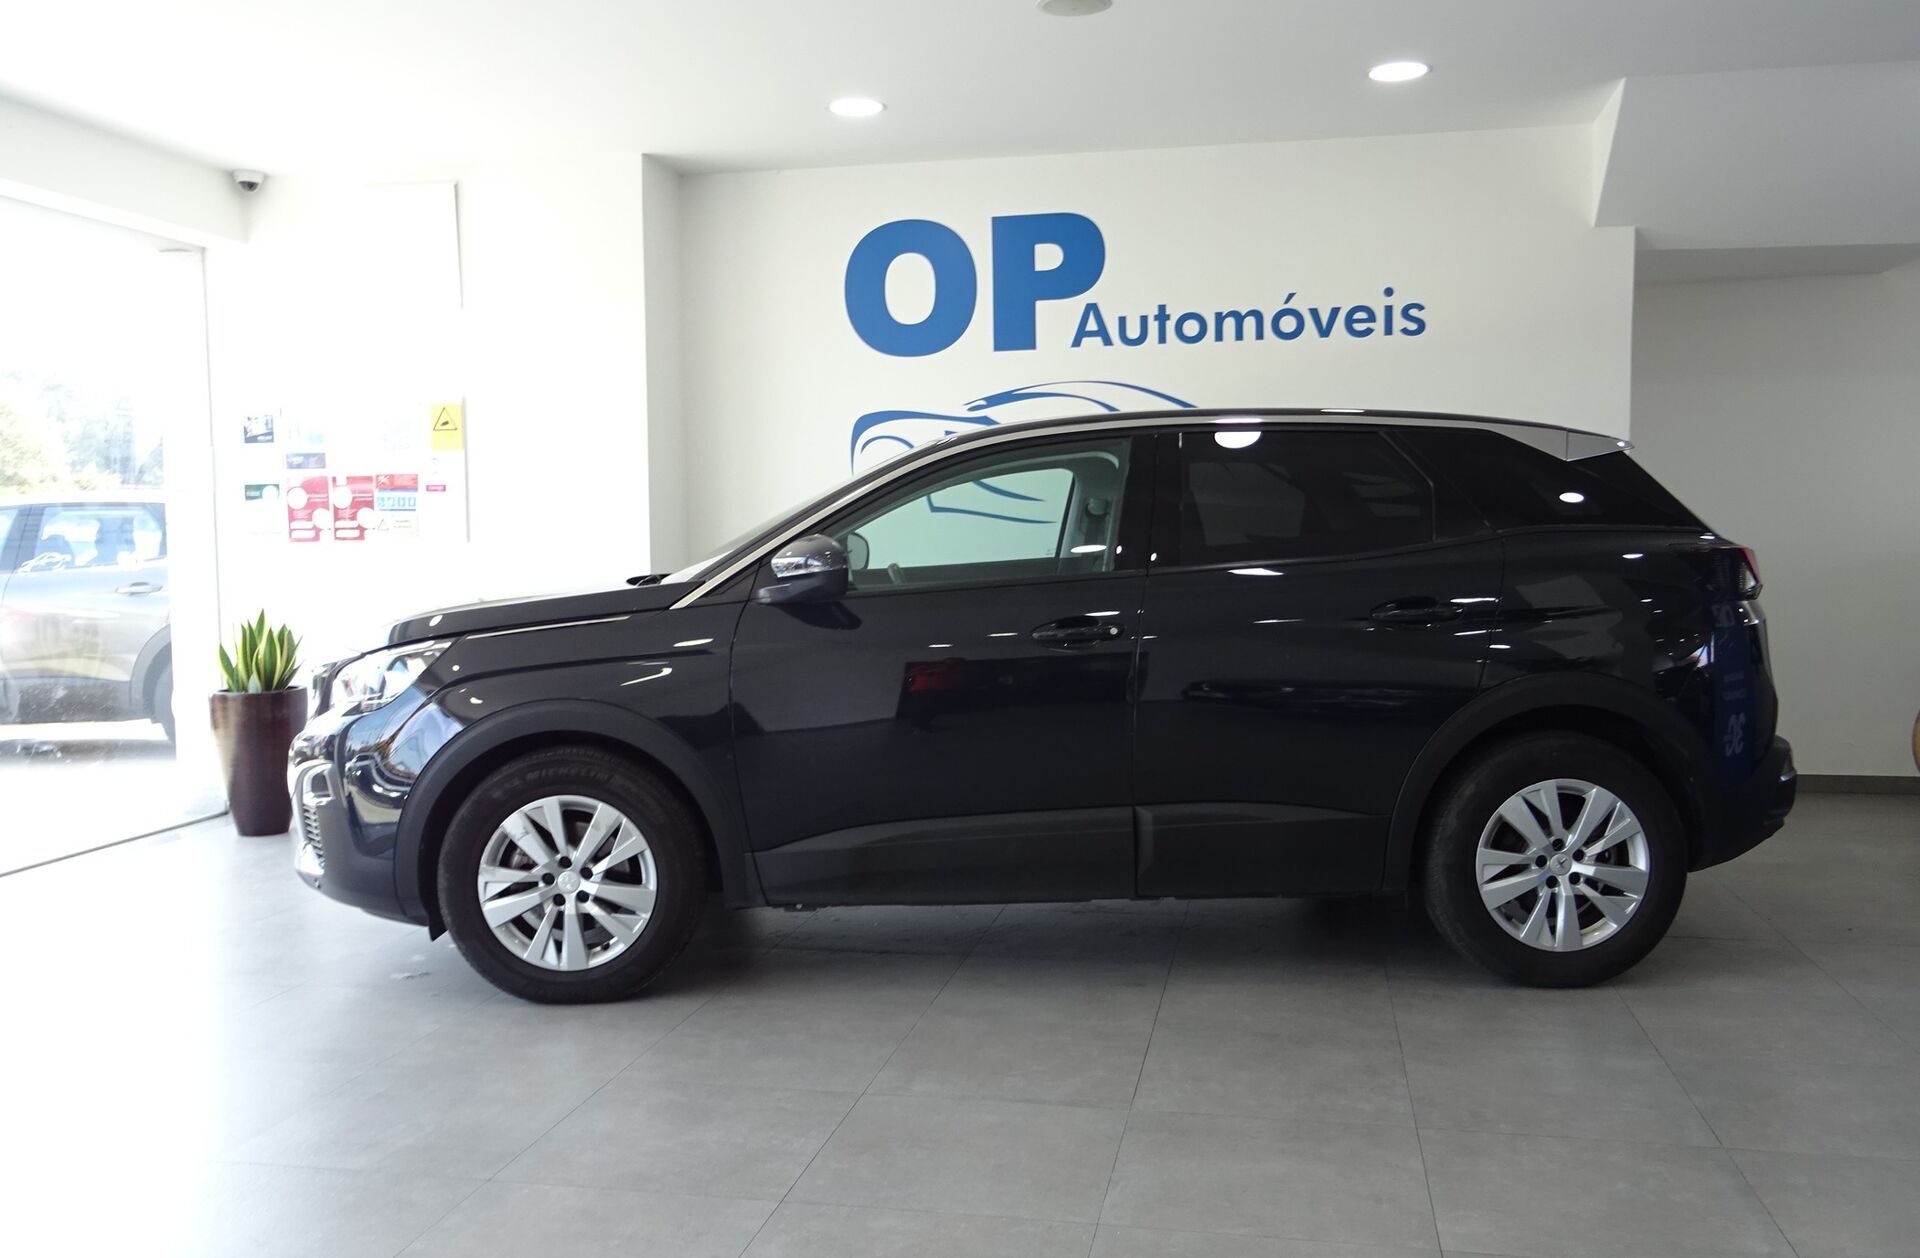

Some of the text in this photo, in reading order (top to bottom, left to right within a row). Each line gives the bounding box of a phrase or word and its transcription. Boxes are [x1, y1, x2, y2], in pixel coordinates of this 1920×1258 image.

[844, 212, 1427, 357] OP Automóveis
[525, 766, 609, 783] MICHELIN
